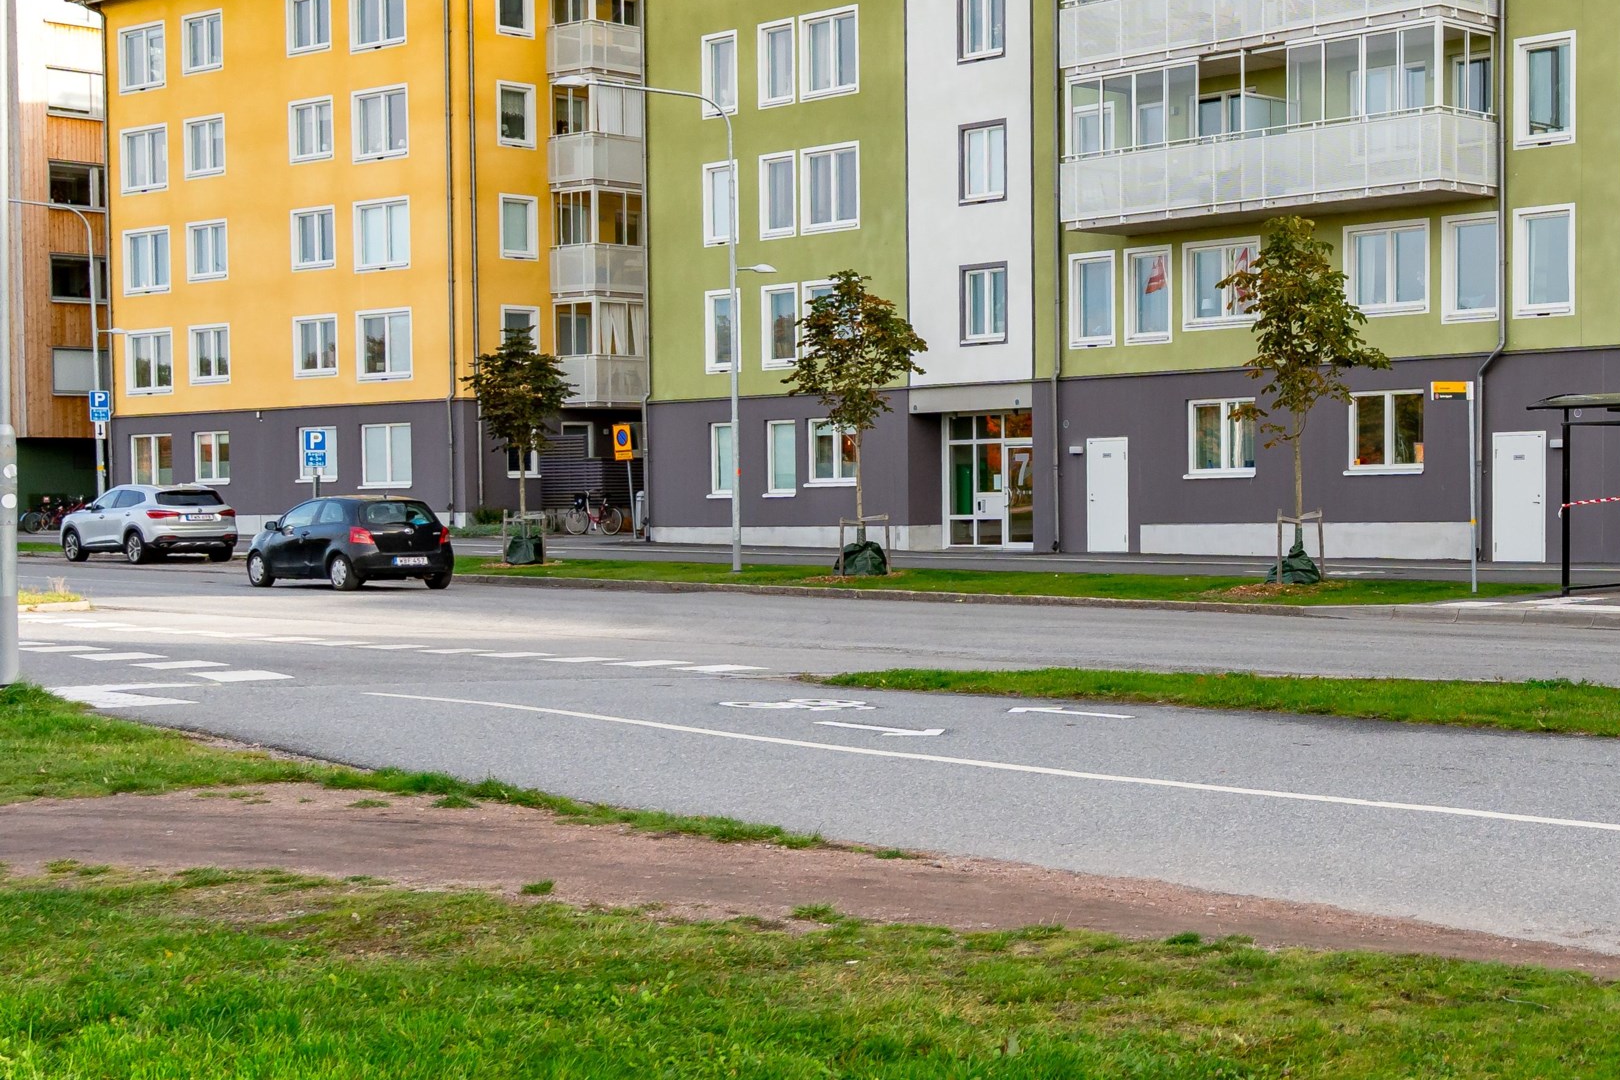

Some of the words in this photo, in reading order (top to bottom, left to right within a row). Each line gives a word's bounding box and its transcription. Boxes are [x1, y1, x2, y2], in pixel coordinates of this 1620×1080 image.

[94, 392, 106, 407] P
[310, 432, 323, 450] P
[1015, 453, 1030, 486] 7
